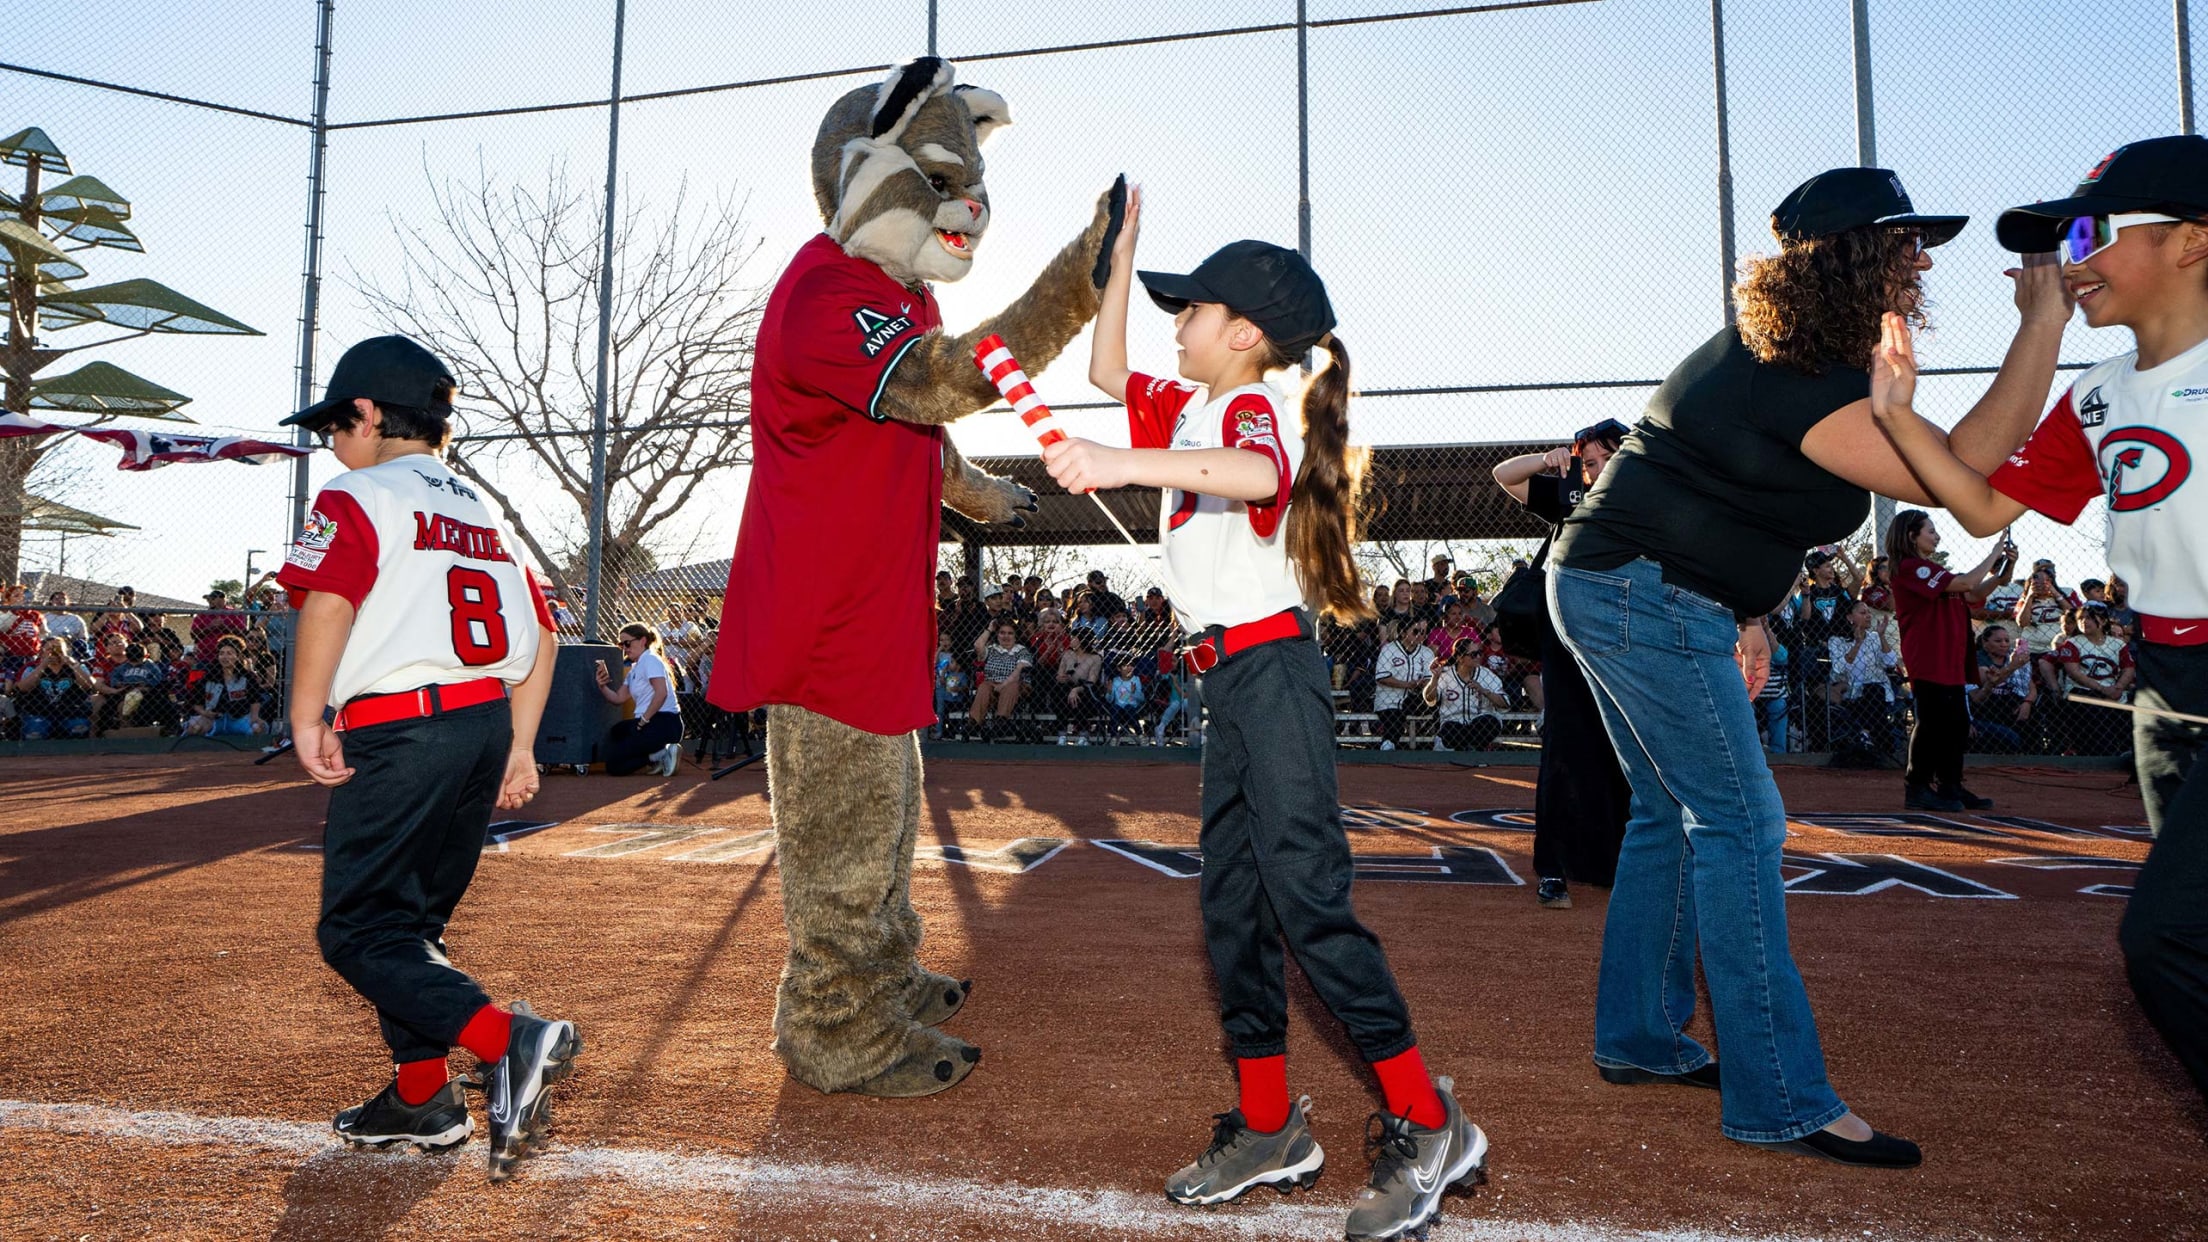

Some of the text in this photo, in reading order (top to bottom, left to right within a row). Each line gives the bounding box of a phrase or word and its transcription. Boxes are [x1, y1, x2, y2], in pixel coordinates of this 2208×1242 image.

[866, 317, 911, 356] AVNET
[413, 511, 517, 567] MENDE
[447, 564, 509, 667] 8
